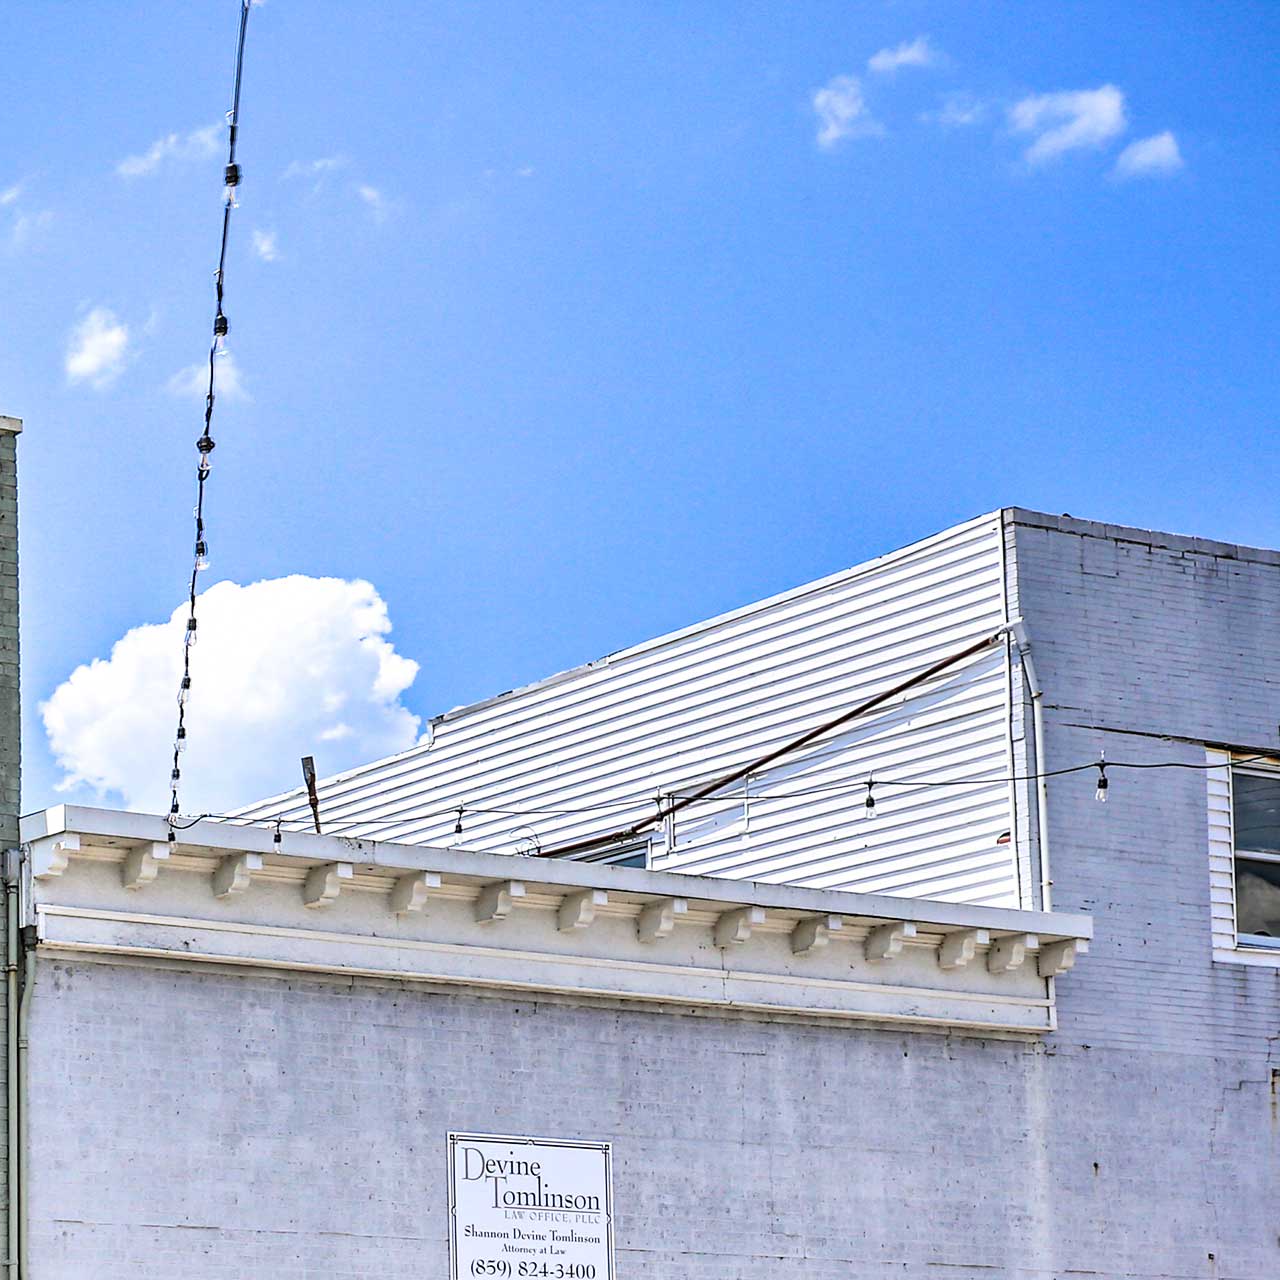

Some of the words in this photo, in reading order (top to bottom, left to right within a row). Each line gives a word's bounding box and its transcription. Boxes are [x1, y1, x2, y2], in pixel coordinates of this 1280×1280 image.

[461, 1147, 541, 1181] Devine
[485, 1174, 601, 1211] Tomlinson
[504, 1210, 526, 1220] LAW
[575, 1214, 601, 1224] PLLC
[464, 1224, 510, 1239] Shannon
[513, 1228, 547, 1241] Devine
[549, 1229, 601, 1244] Tomlinson
[502, 1244, 537, 1256] Attorney
[550, 1246, 566, 1255] Law
[470, 1259, 512, 1279] (859)
[518, 1260, 596, 1280] 824-3400
